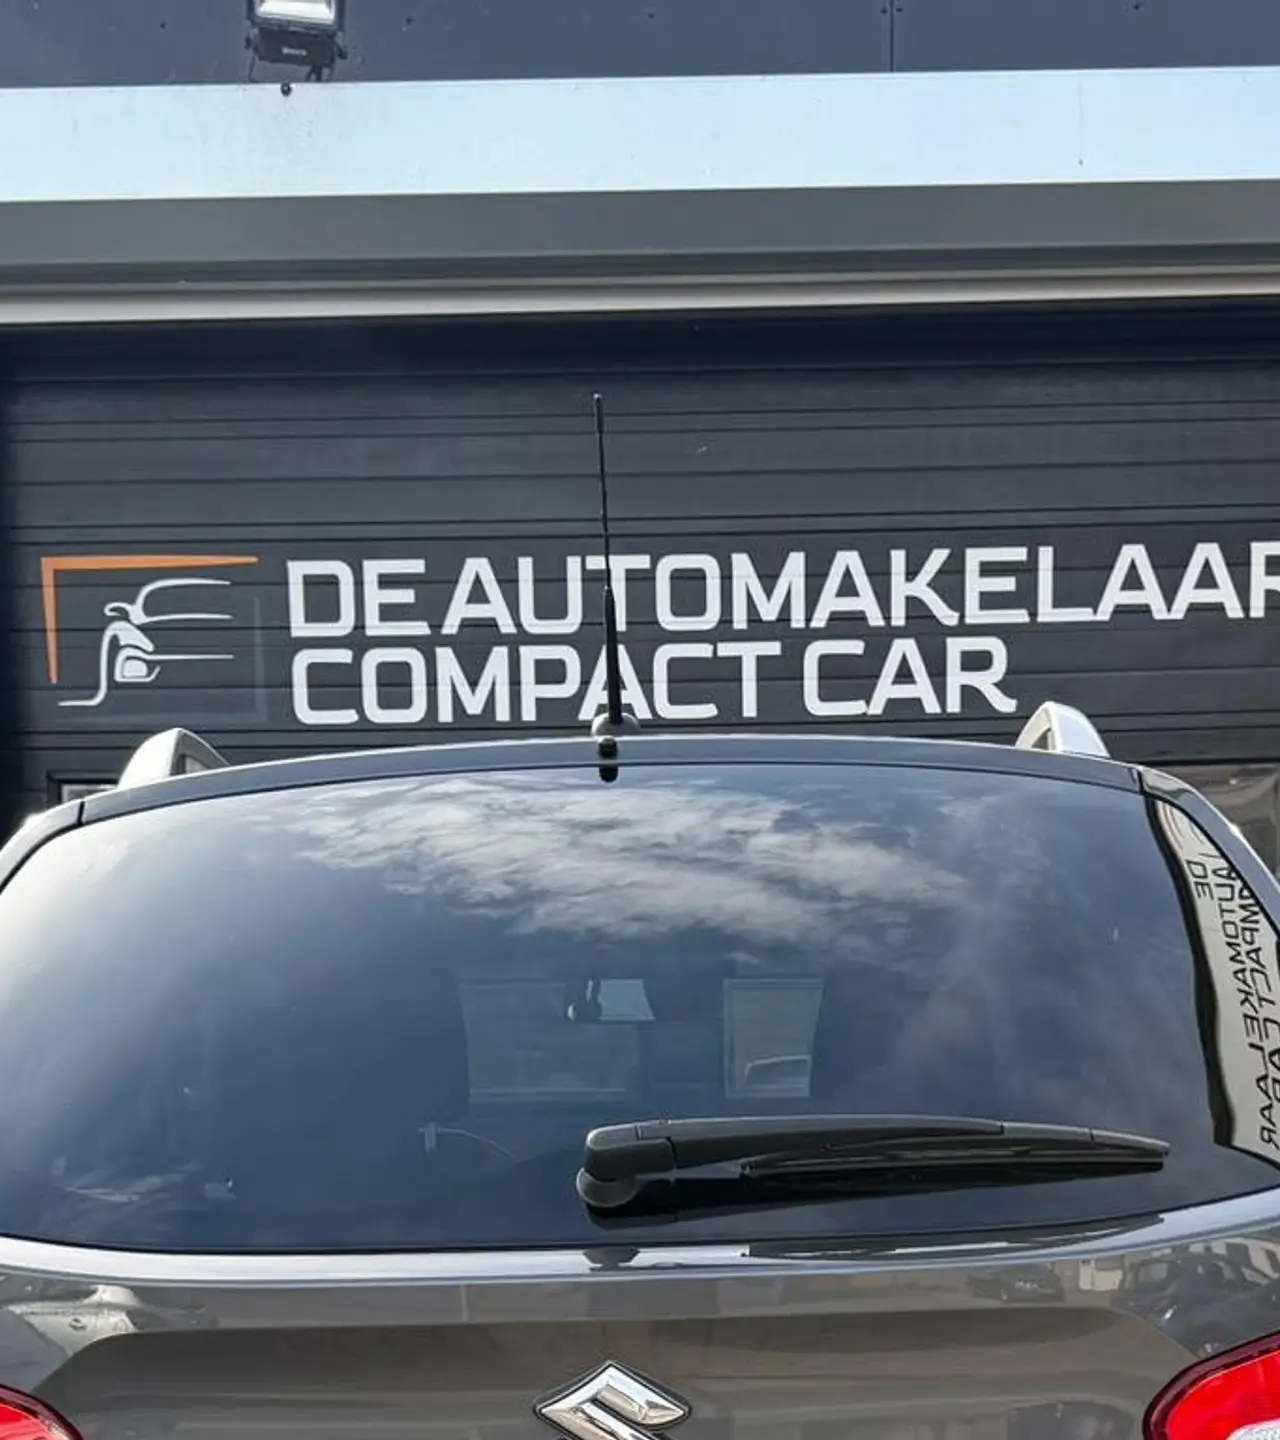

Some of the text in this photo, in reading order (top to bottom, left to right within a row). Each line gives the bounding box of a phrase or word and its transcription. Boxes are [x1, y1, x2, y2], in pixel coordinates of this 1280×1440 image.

[286, 557, 431, 638] DE
[292, 636, 1017, 725] COMPACT CAR
